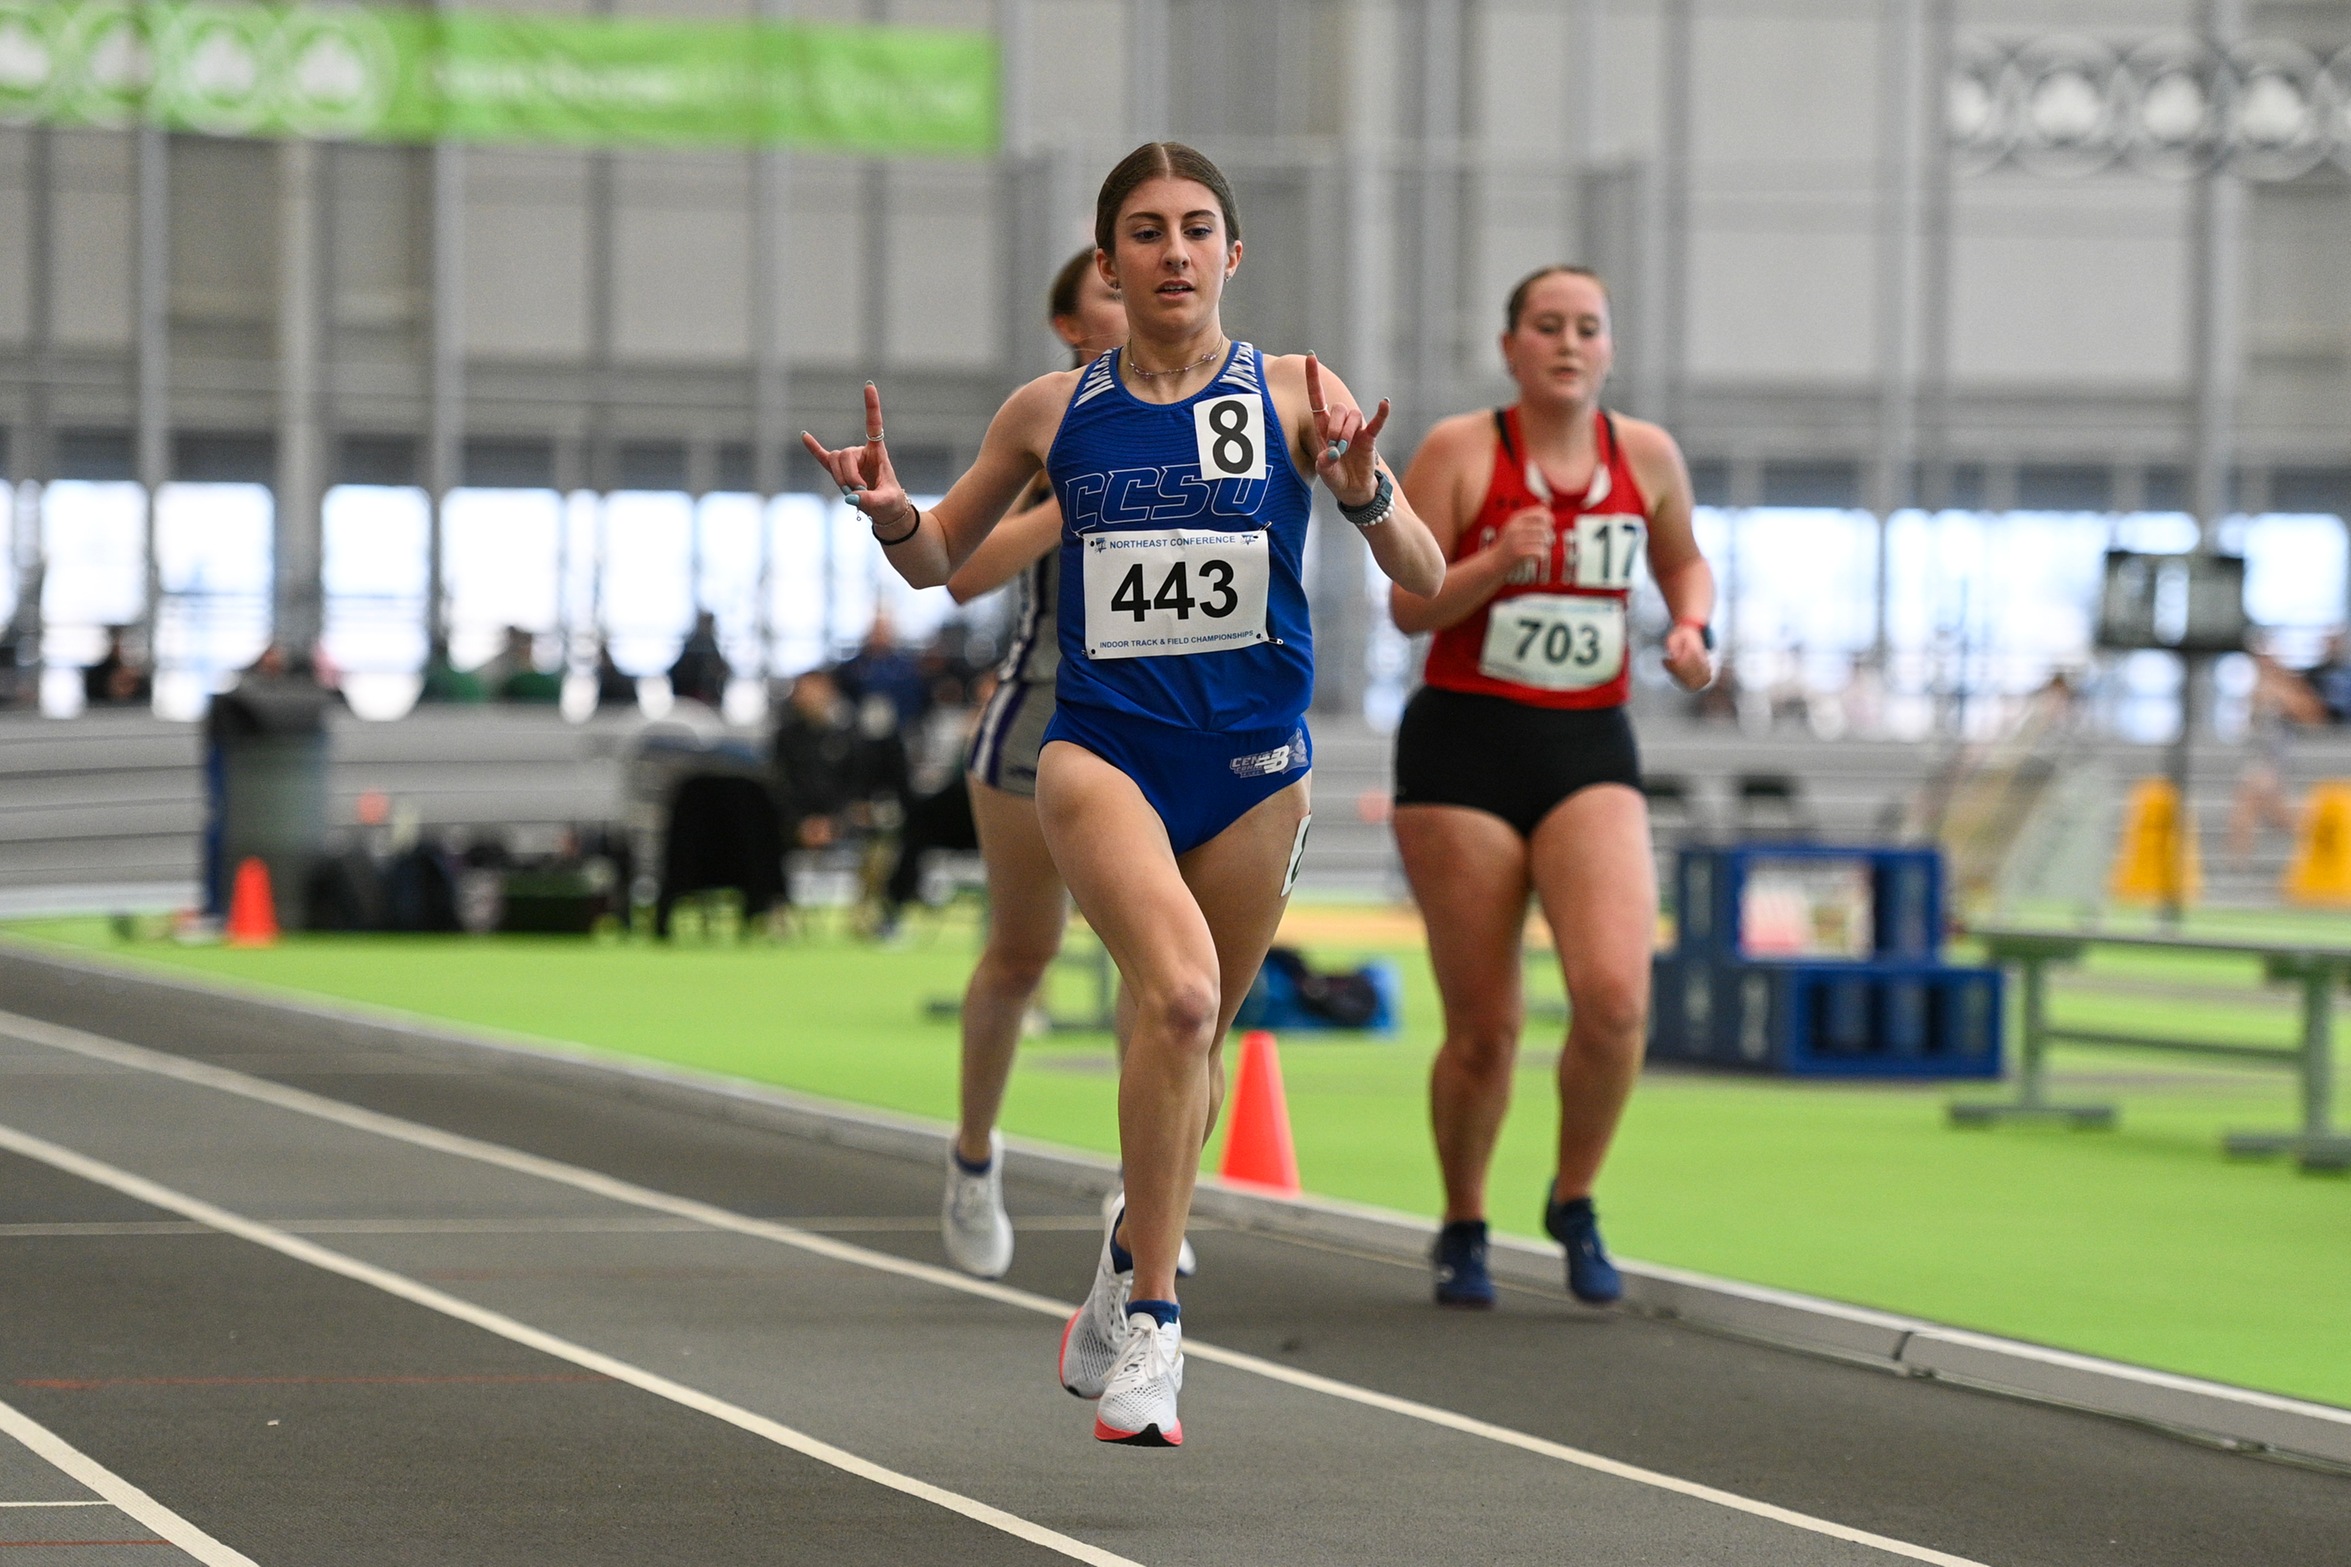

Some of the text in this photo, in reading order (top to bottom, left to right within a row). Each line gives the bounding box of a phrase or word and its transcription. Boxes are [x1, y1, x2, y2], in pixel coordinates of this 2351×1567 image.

[1209, 399, 1254, 475] 8
[1065, 463, 1274, 532] CCSU
[1109, 535, 1236, 549] NORTHEAST CONFERENCE
[1594, 522, 1639, 580] 17
[1111, 559, 1238, 622] 443
[1099, 630, 1254, 649] INDOOR TRACK & FIELD CHAMPIONSHIPS
[1515, 617, 1601, 667] 703
